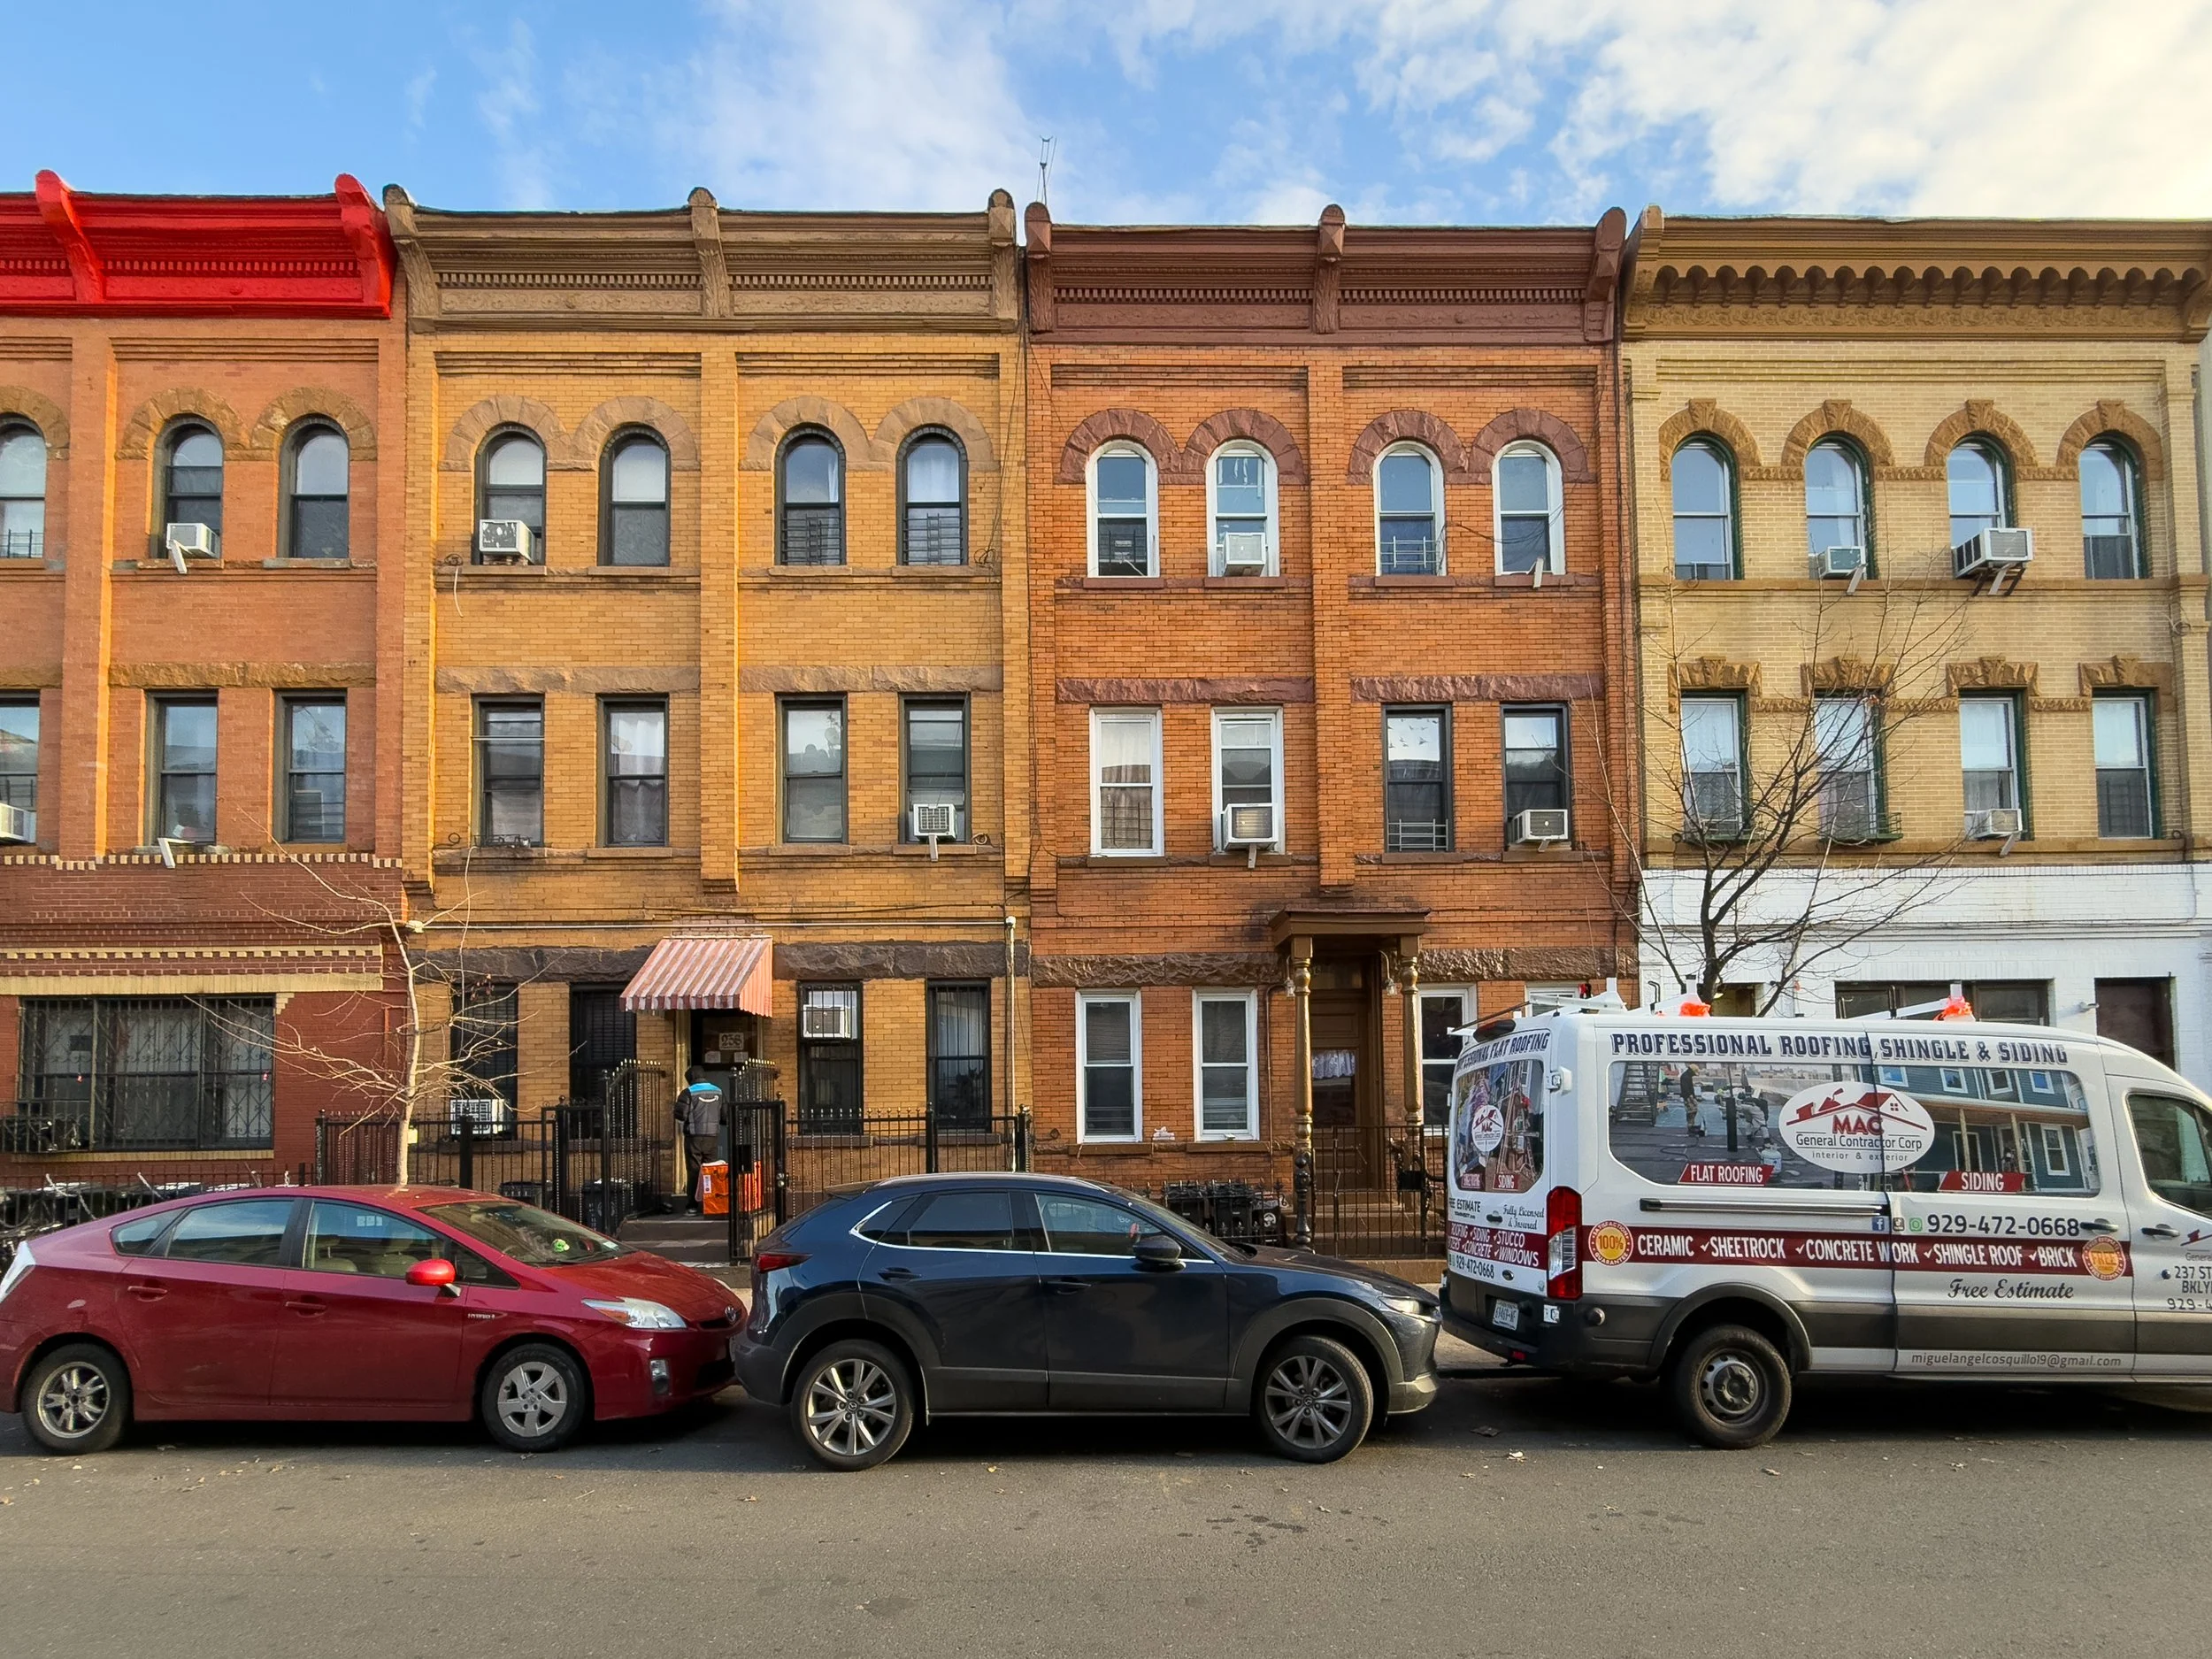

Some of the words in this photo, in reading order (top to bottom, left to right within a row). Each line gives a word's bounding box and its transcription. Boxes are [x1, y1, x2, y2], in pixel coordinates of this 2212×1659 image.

[1489, 1038, 1510, 1059] FLAT
[1509, 1032, 1550, 1054] ROOFING
[1609, 1033, 1772, 1056] PROFESSIONAL
[1879, 1038, 1970, 1062] SHINGLE
[1976, 1041, 1991, 1062] &
[1997, 1041, 2069, 1065] SIDING
[1832, 1114, 1885, 1136] MAC
[1796, 1133, 1837, 1147] General
[1841, 1134, 1896, 1148] Contractor
[1898, 1136, 1923, 1152] Corp
[1498, 1174, 1515, 1189] SIDING
[1691, 1164, 1714, 1182] FLAT
[1718, 1165, 1763, 1183] ROOFING
[1961, 1171, 2004, 1192] SIDING
[1456, 1199, 1481, 1213] ESTIMATE
[1503, 1204, 1517, 1216] Fully
[1518, 1205, 1545, 1218] Licensed
[1514, 1217, 1537, 1230] Insured
[1592, 1221, 1629, 1239] SATISFACTION
[1926, 1213, 2079, 1236] 929-472-0668
[1473, 1226, 1491, 1243] SIDING
[1497, 1231, 1525, 1248] STUCCO
[1598, 1235, 1624, 1250] 100%
[1464, 1240, 1493, 1258] CONCRETE
[1499, 1246, 1540, 1267] WINDOWS
[1594, 1251, 1629, 1265] GUARANTEE
[1638, 1233, 1695, 1257] CERAMIC
[1709, 1235, 1786, 1259] SHEETROCK
[1806, 1239, 1874, 1262] CONCRETE
[1876, 1241, 1920, 1263] WORK
[1934, 1243, 1987, 1265] SHINGLE
[1989, 1245, 2023, 1267] ROOF
[2037, 1246, 2078, 1268] BRICK
[2185, 1252, 2212, 1262] Genera
[1455, 1255, 1495, 1279] 929-472-0668
[2174, 1265, 2195, 1279] 237
[1947, 1278, 1989, 1299] Free
[1993, 1278, 2074, 1299] Estimate
[2182, 1280, 2212, 1294] BKLY
[1911, 1353, 2122, 1369] miguelangelcosquillo19@gmail.com
